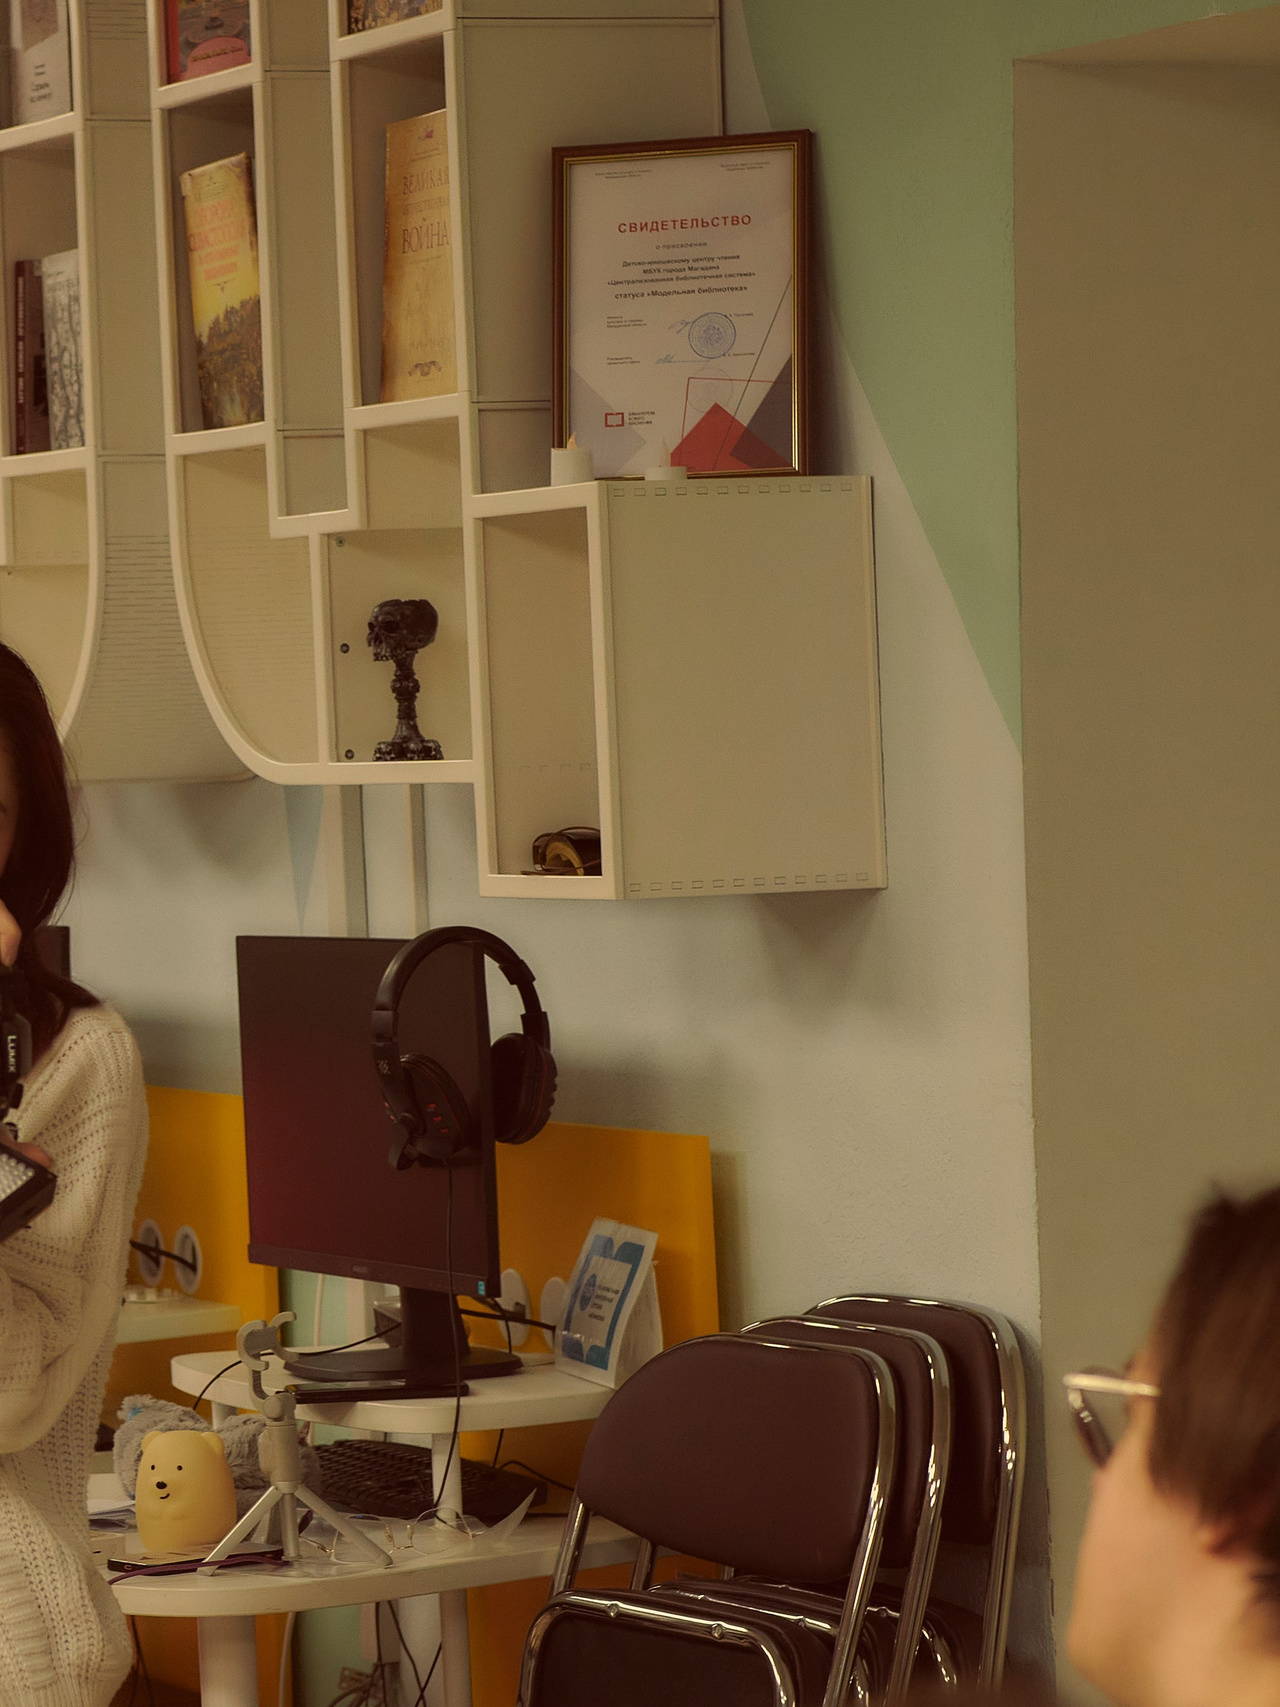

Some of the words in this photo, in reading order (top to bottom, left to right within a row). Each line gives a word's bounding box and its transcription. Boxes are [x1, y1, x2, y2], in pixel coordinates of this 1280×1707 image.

[617, 214, 752, 234] СВИДЕТЕЛЬСТВО
[402, 217, 450, 254] ВОЙНА
[622, 258, 691, 267] Детско-юношескому
[675, 274, 723, 282] библиотечная
[615, 292, 645, 300] статуса
[647, 289, 696, 298] «Модельная
[697, 285, 748, 295] библиотека»
[7, 1035, 18, 1073] LUMIX
